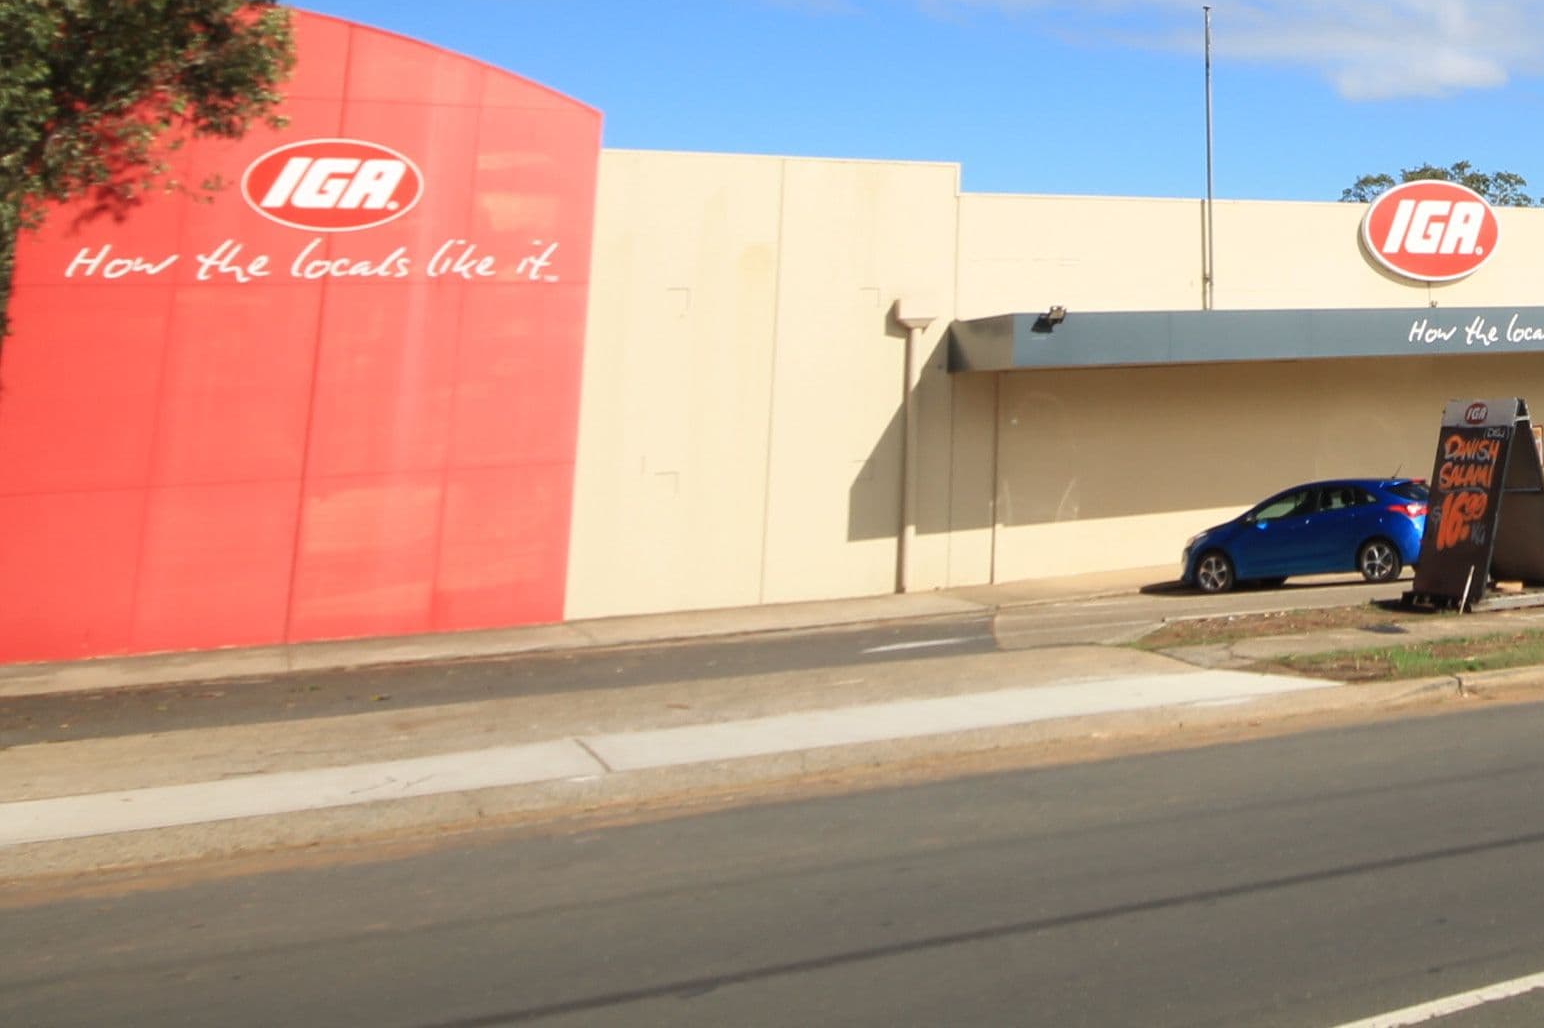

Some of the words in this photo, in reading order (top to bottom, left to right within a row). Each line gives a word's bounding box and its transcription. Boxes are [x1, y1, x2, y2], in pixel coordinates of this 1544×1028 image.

[260, 156, 402, 210] IGA
[1382, 199, 1484, 256] IGA
[64, 244, 179, 279] How
[196, 239, 270, 283] the
[291, 237, 411, 280] locals
[426, 239, 496, 279] like
[1409, 314, 1458, 344] How
[1465, 315, 1499, 345] the
[1467, 407, 1487, 420] IGA
[1444, 434, 1501, 464] DANISH
[1438, 462, 1495, 490] SALAMI
